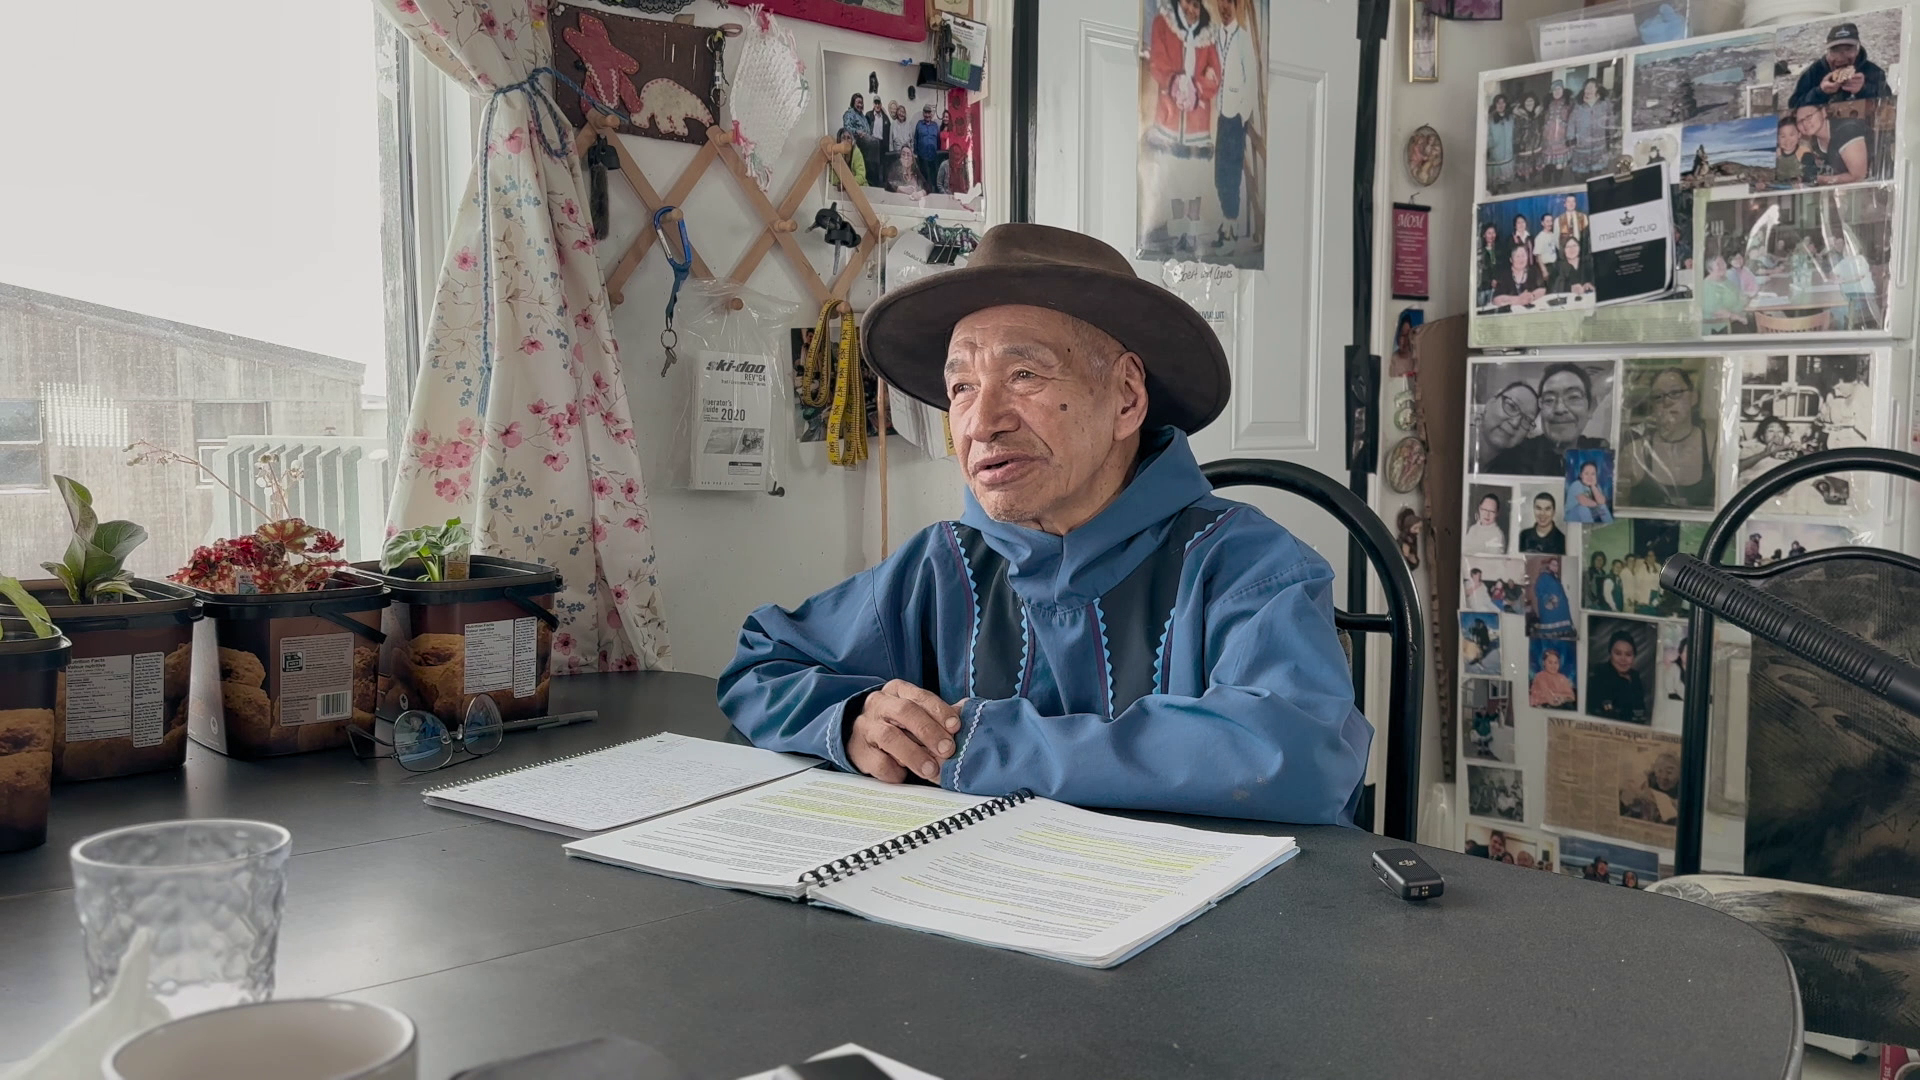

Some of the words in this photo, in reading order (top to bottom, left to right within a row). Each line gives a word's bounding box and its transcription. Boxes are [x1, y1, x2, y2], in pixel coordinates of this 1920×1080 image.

[1397, 213, 1425, 228] MOM
[706, 359, 766, 374] ski-doo
[720, 408, 746, 422] 2020
